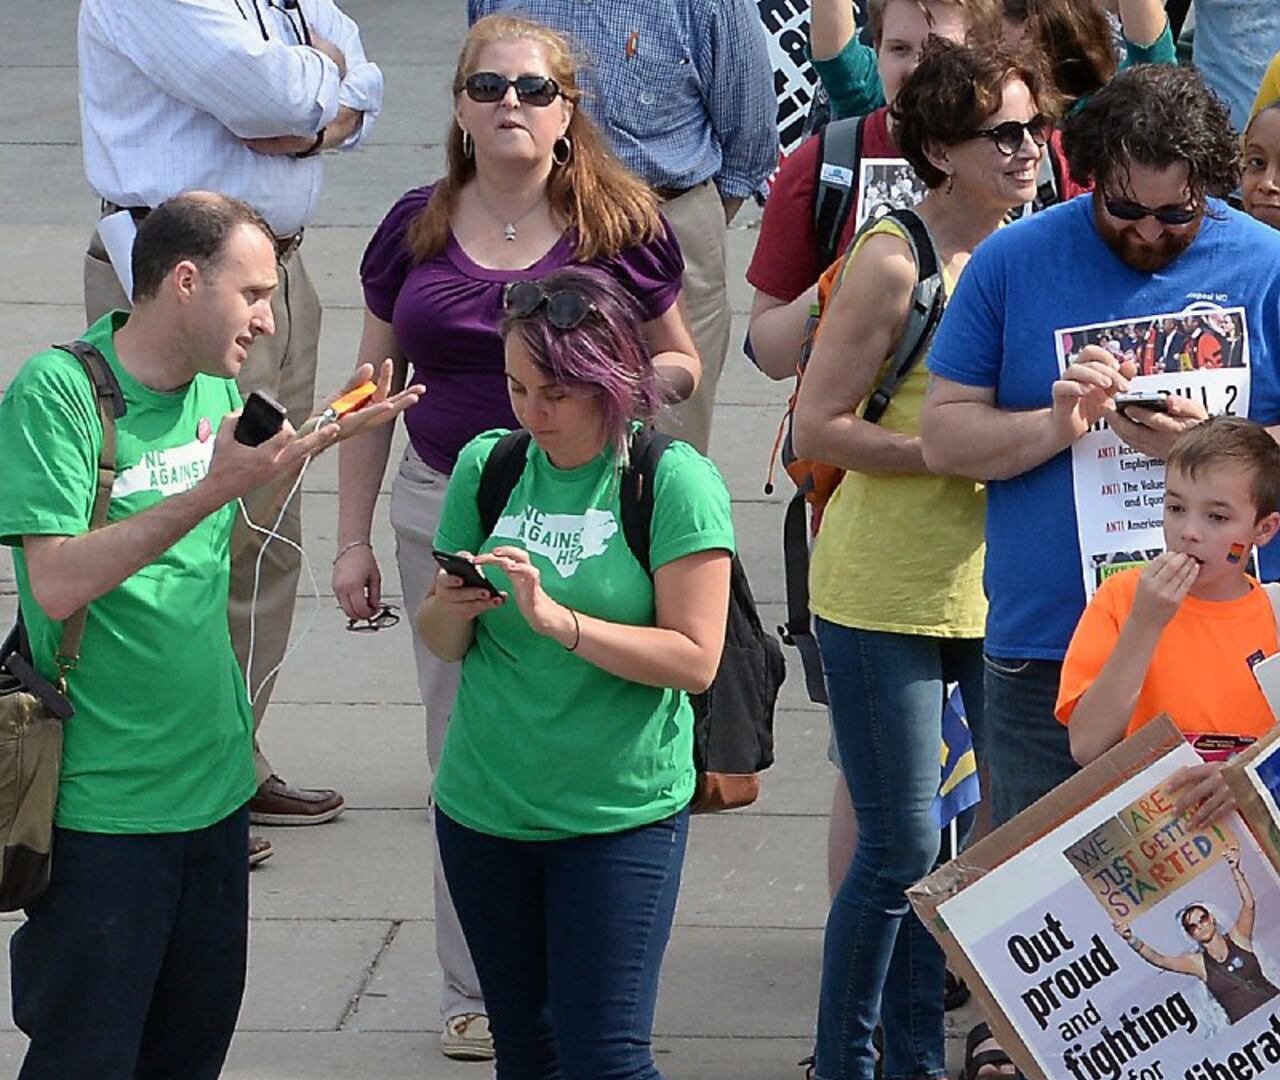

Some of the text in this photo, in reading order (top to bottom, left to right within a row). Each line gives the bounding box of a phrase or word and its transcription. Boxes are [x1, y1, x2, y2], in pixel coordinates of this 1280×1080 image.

[1225, 385, 1238, 416] 2
[1140, 481, 1164, 492] Value
[518, 521, 584, 548] AGAINS
[1073, 790, 1173, 867] WE ARE
[1092, 799, 1205, 896] JUST GETT
[1007, 912, 1074, 975] Out
[1020, 935, 1119, 1030] proud
[1057, 1000, 1101, 1041] and
